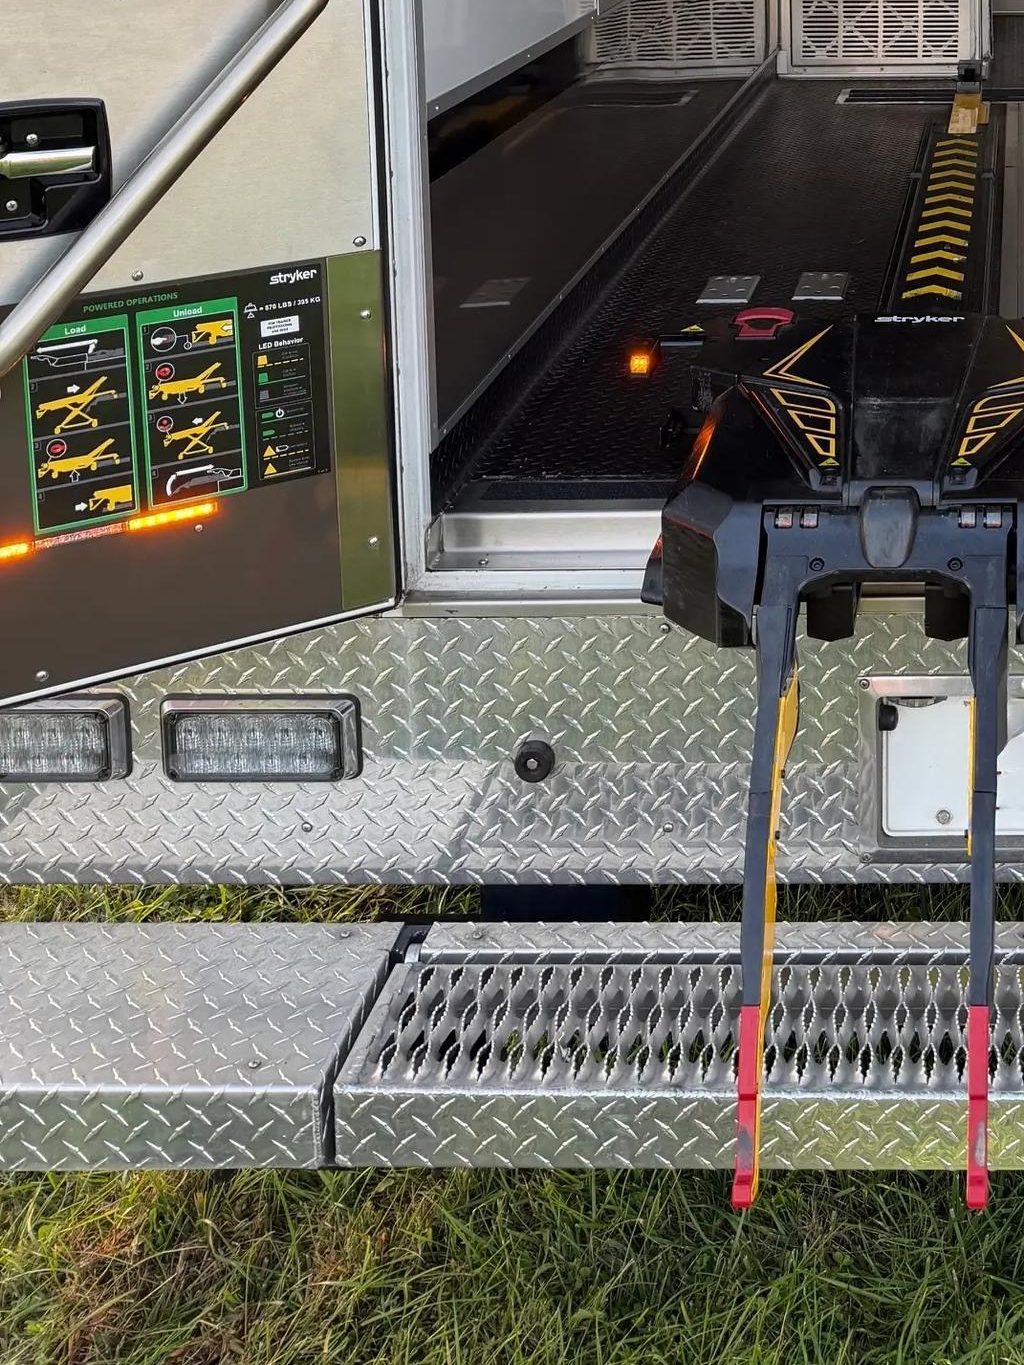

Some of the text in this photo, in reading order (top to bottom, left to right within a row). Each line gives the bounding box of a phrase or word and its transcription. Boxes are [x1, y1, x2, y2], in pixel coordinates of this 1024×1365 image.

[269, 269, 317, 285] stryker
[83, 292, 178, 313] POWERED OPERATIONS
[173, 306, 203, 318] Unload
[874, 315, 965, 324] stryker
[64, 325, 86, 335] Load
[258, 337, 304, 350] LED Behavior
